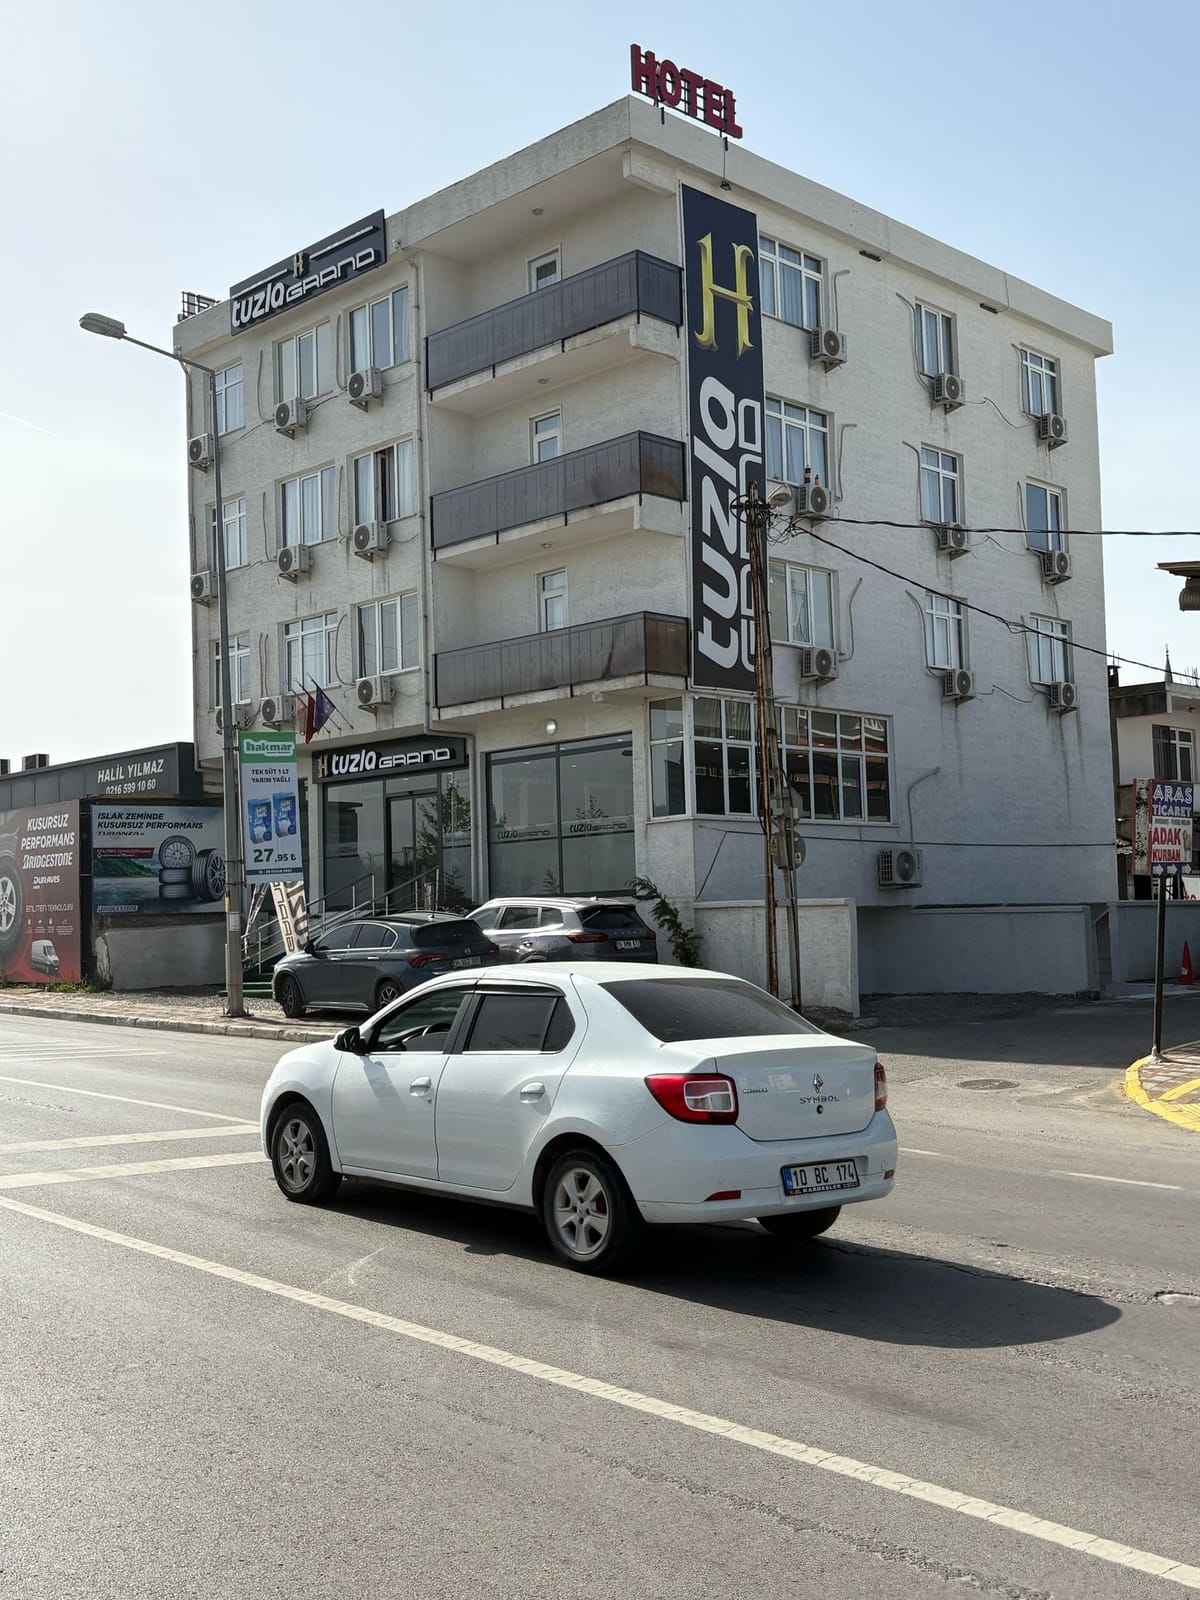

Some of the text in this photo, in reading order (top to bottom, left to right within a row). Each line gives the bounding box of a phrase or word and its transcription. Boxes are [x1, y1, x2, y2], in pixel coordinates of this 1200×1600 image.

[630, 43, 743, 139] HOTEL
[246, 741, 292, 752] hakmar
[97, 758, 164, 784] HALİL YILMAZ
[272, 775, 291, 784] YAĞLI
[122, 782, 136, 794] 599
[137, 780, 146, 792] 10
[147, 778, 156, 790] 60
[1152, 784, 1192, 805] ARAS
[1152, 802, 1192, 817] TİCARET
[27, 814, 69, 831] KUSURSUZ
[145, 821, 204, 830] PERFORMANS
[21, 831, 75, 850] PERFORMANS
[1152, 827, 1182, 846] ADAK
[22, 851, 73, 870] BRIDGESTONE
[1152, 848, 1181, 861] KURBAN
[799, 1095, 840, 1105] SYMBOL
[793, 1164, 855, 1187] 10 BC 174
